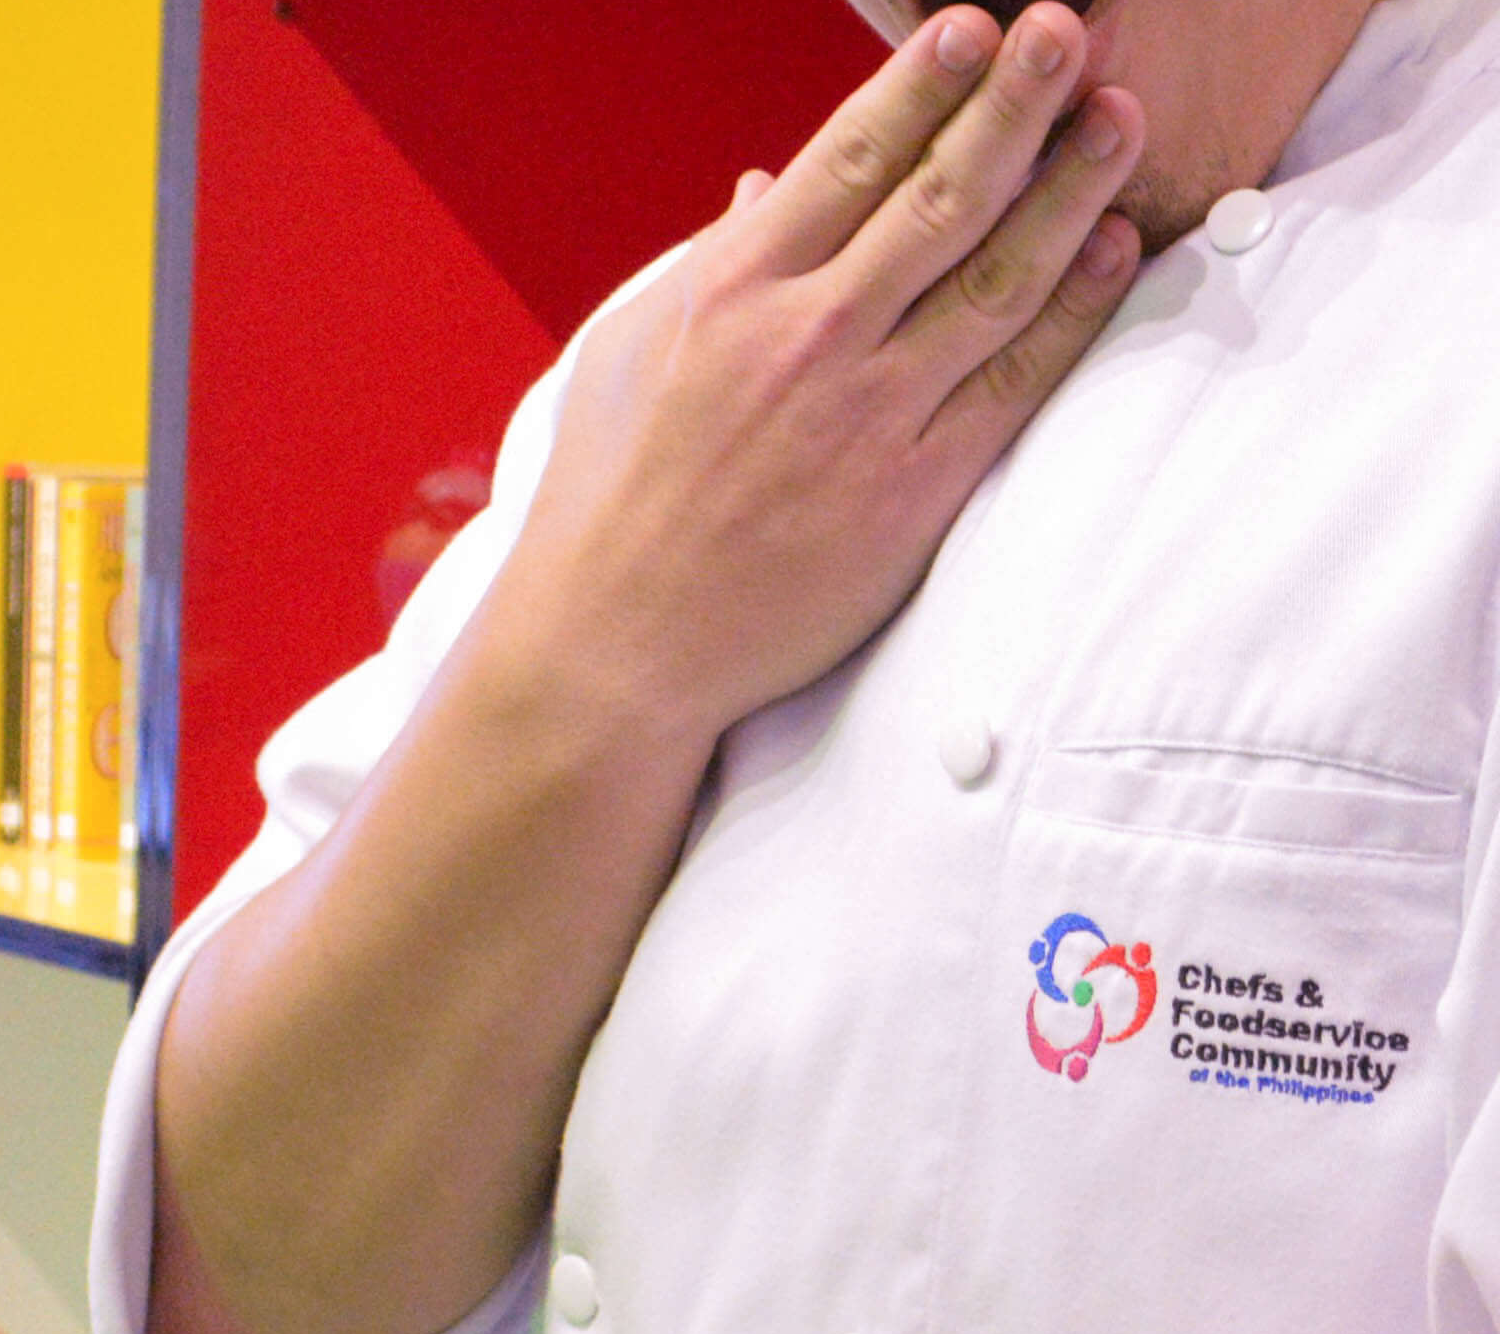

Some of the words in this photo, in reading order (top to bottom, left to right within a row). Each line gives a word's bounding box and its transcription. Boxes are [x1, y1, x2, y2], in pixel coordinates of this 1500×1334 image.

[1177, 965, 1284, 1004] Chefs
[1295, 979, 1324, 1008] &
[1171, 997, 1410, 1052] Foodservice
[1170, 1033, 1396, 1092] Community
[1189, 1068, 1209, 1084] of
[1216, 1071, 1250, 1091] the
[1257, 1076, 1375, 1105] Philippines
